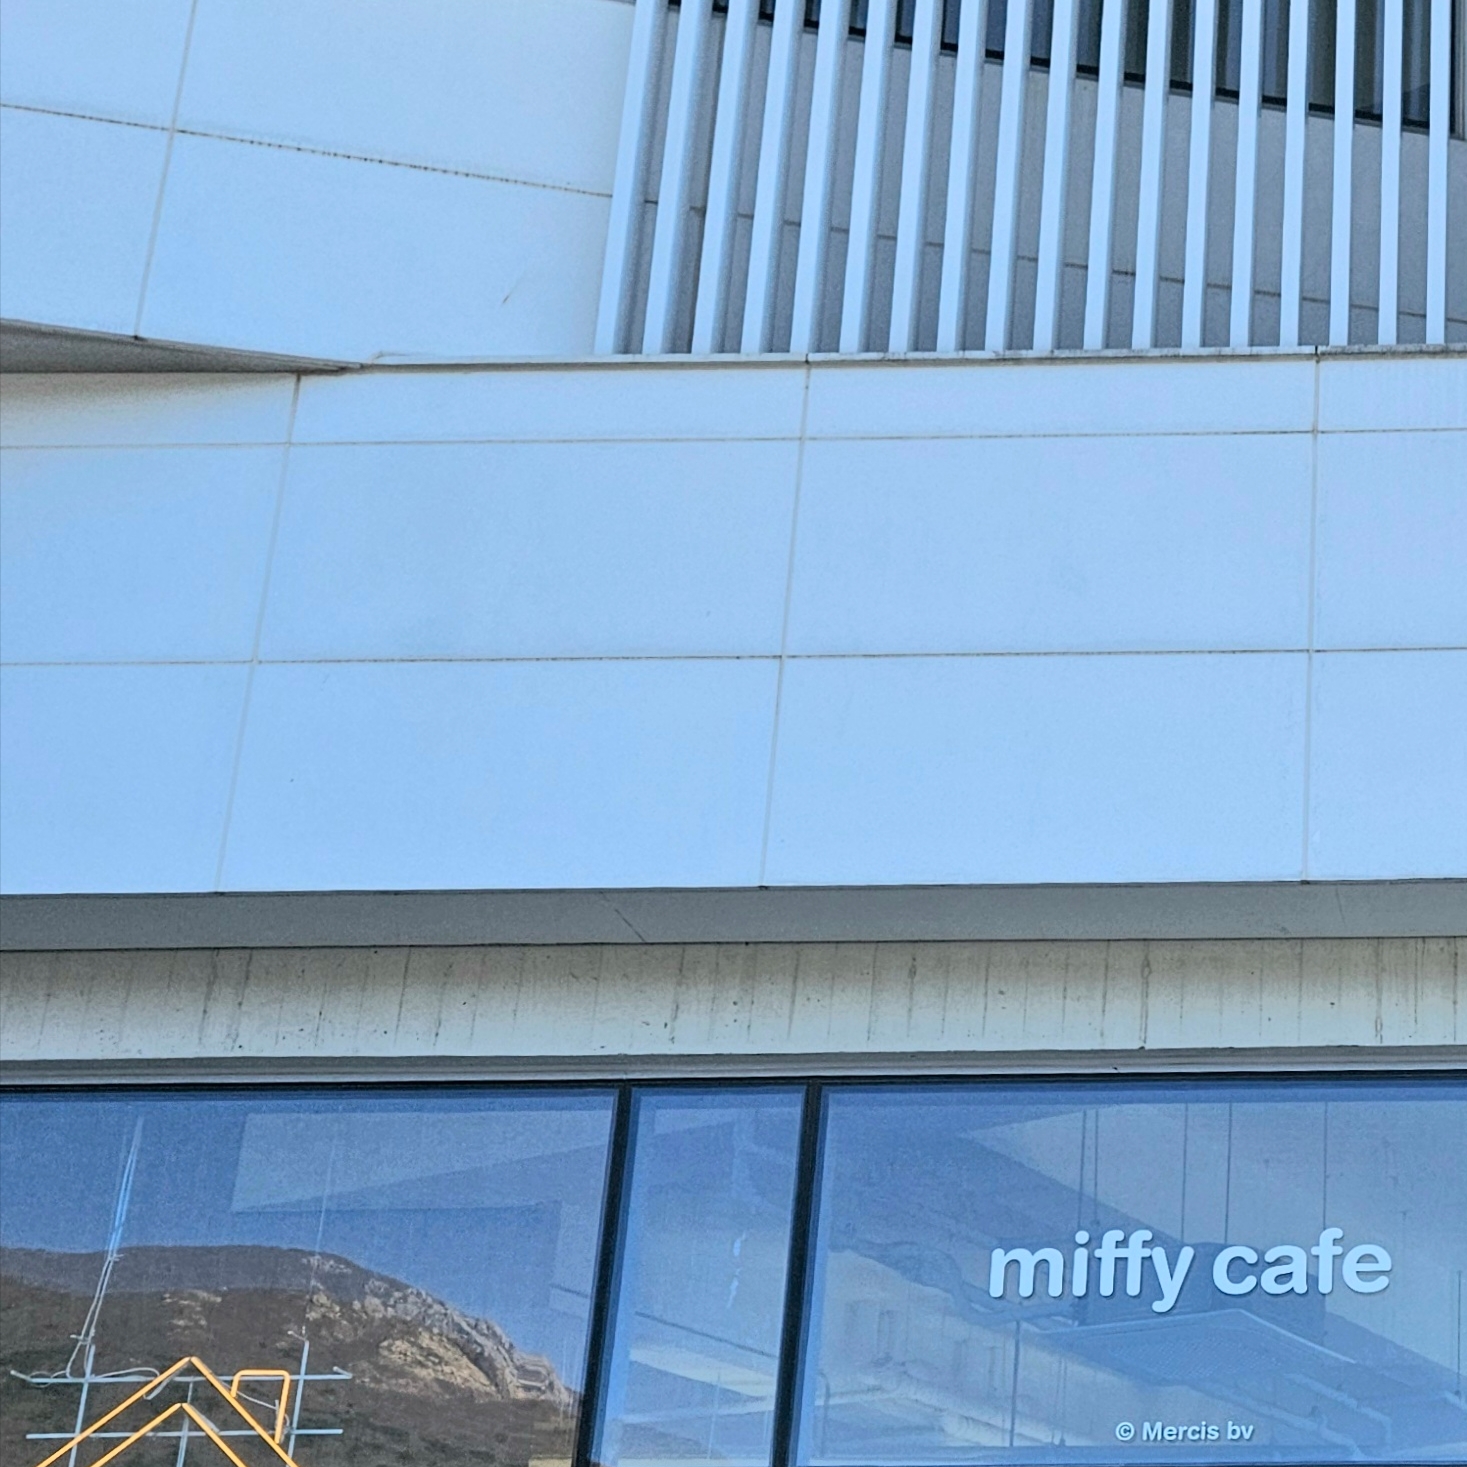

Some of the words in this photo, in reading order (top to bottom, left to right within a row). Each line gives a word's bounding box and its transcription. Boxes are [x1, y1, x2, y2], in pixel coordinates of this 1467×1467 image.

[989, 1229, 1195, 1313] miffy
[1212, 1227, 1393, 1295] cafe
[1142, 1421, 1219, 1441] Mercis
[1227, 1420, 1254, 1440] bv
